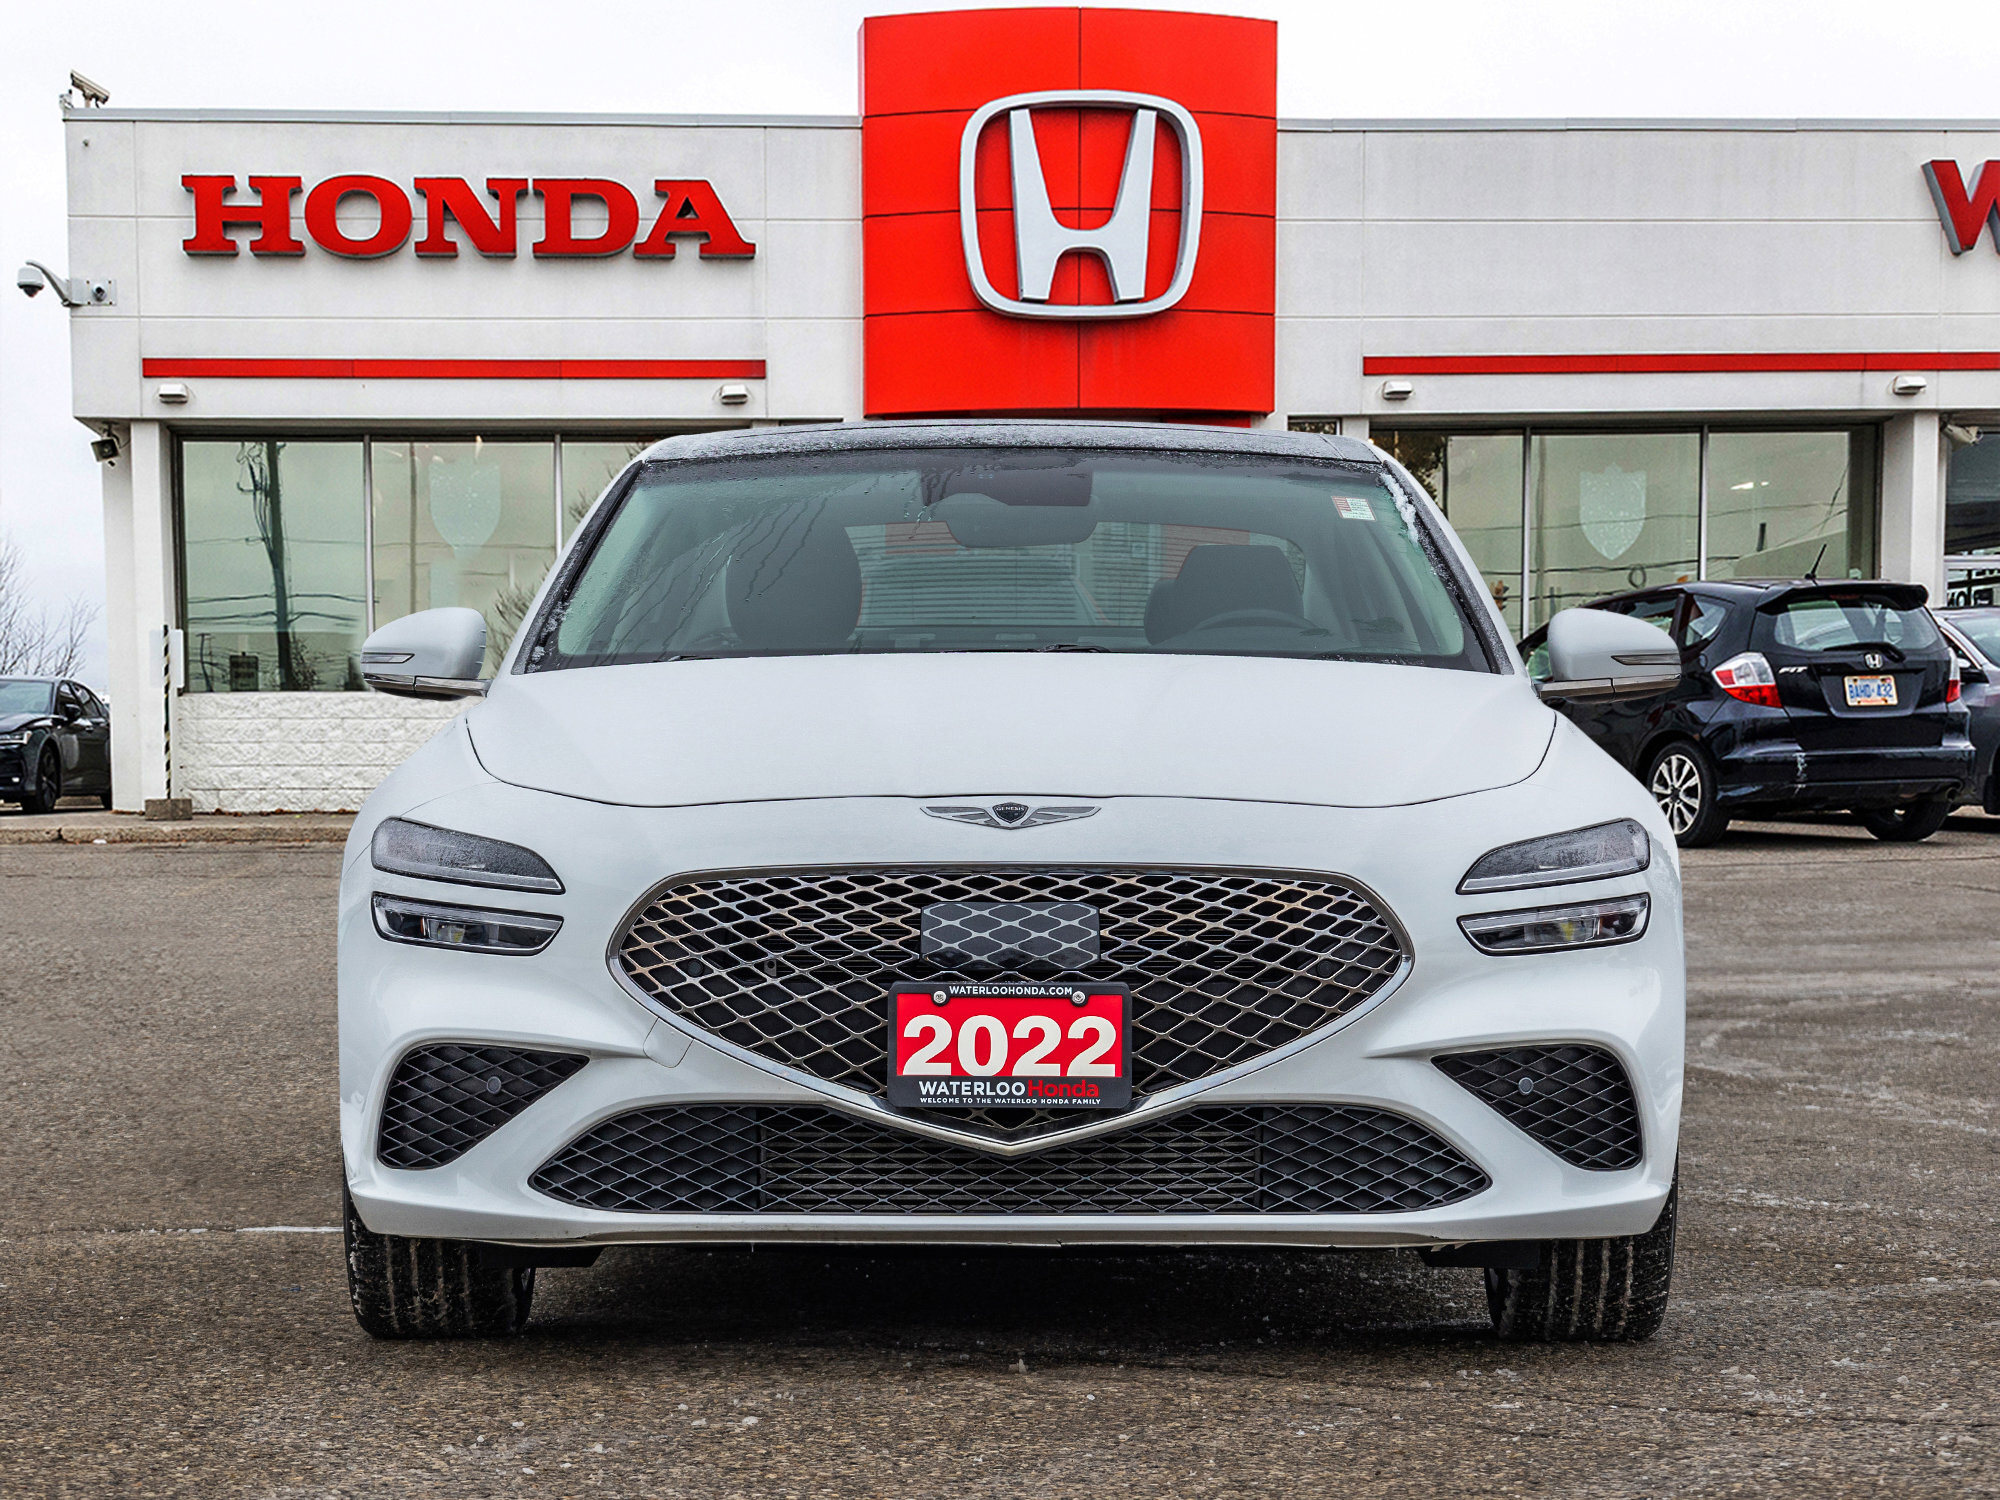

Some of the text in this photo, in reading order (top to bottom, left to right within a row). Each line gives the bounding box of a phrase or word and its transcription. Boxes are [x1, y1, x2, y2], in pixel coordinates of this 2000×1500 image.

[181, 174, 756, 260] HONDA
[949, 985, 1073, 996] WATERLOOHONDA.COM
[902, 1014, 1117, 1077] 2022
[918, 1079, 1099, 1097] WATERLOO Honda
